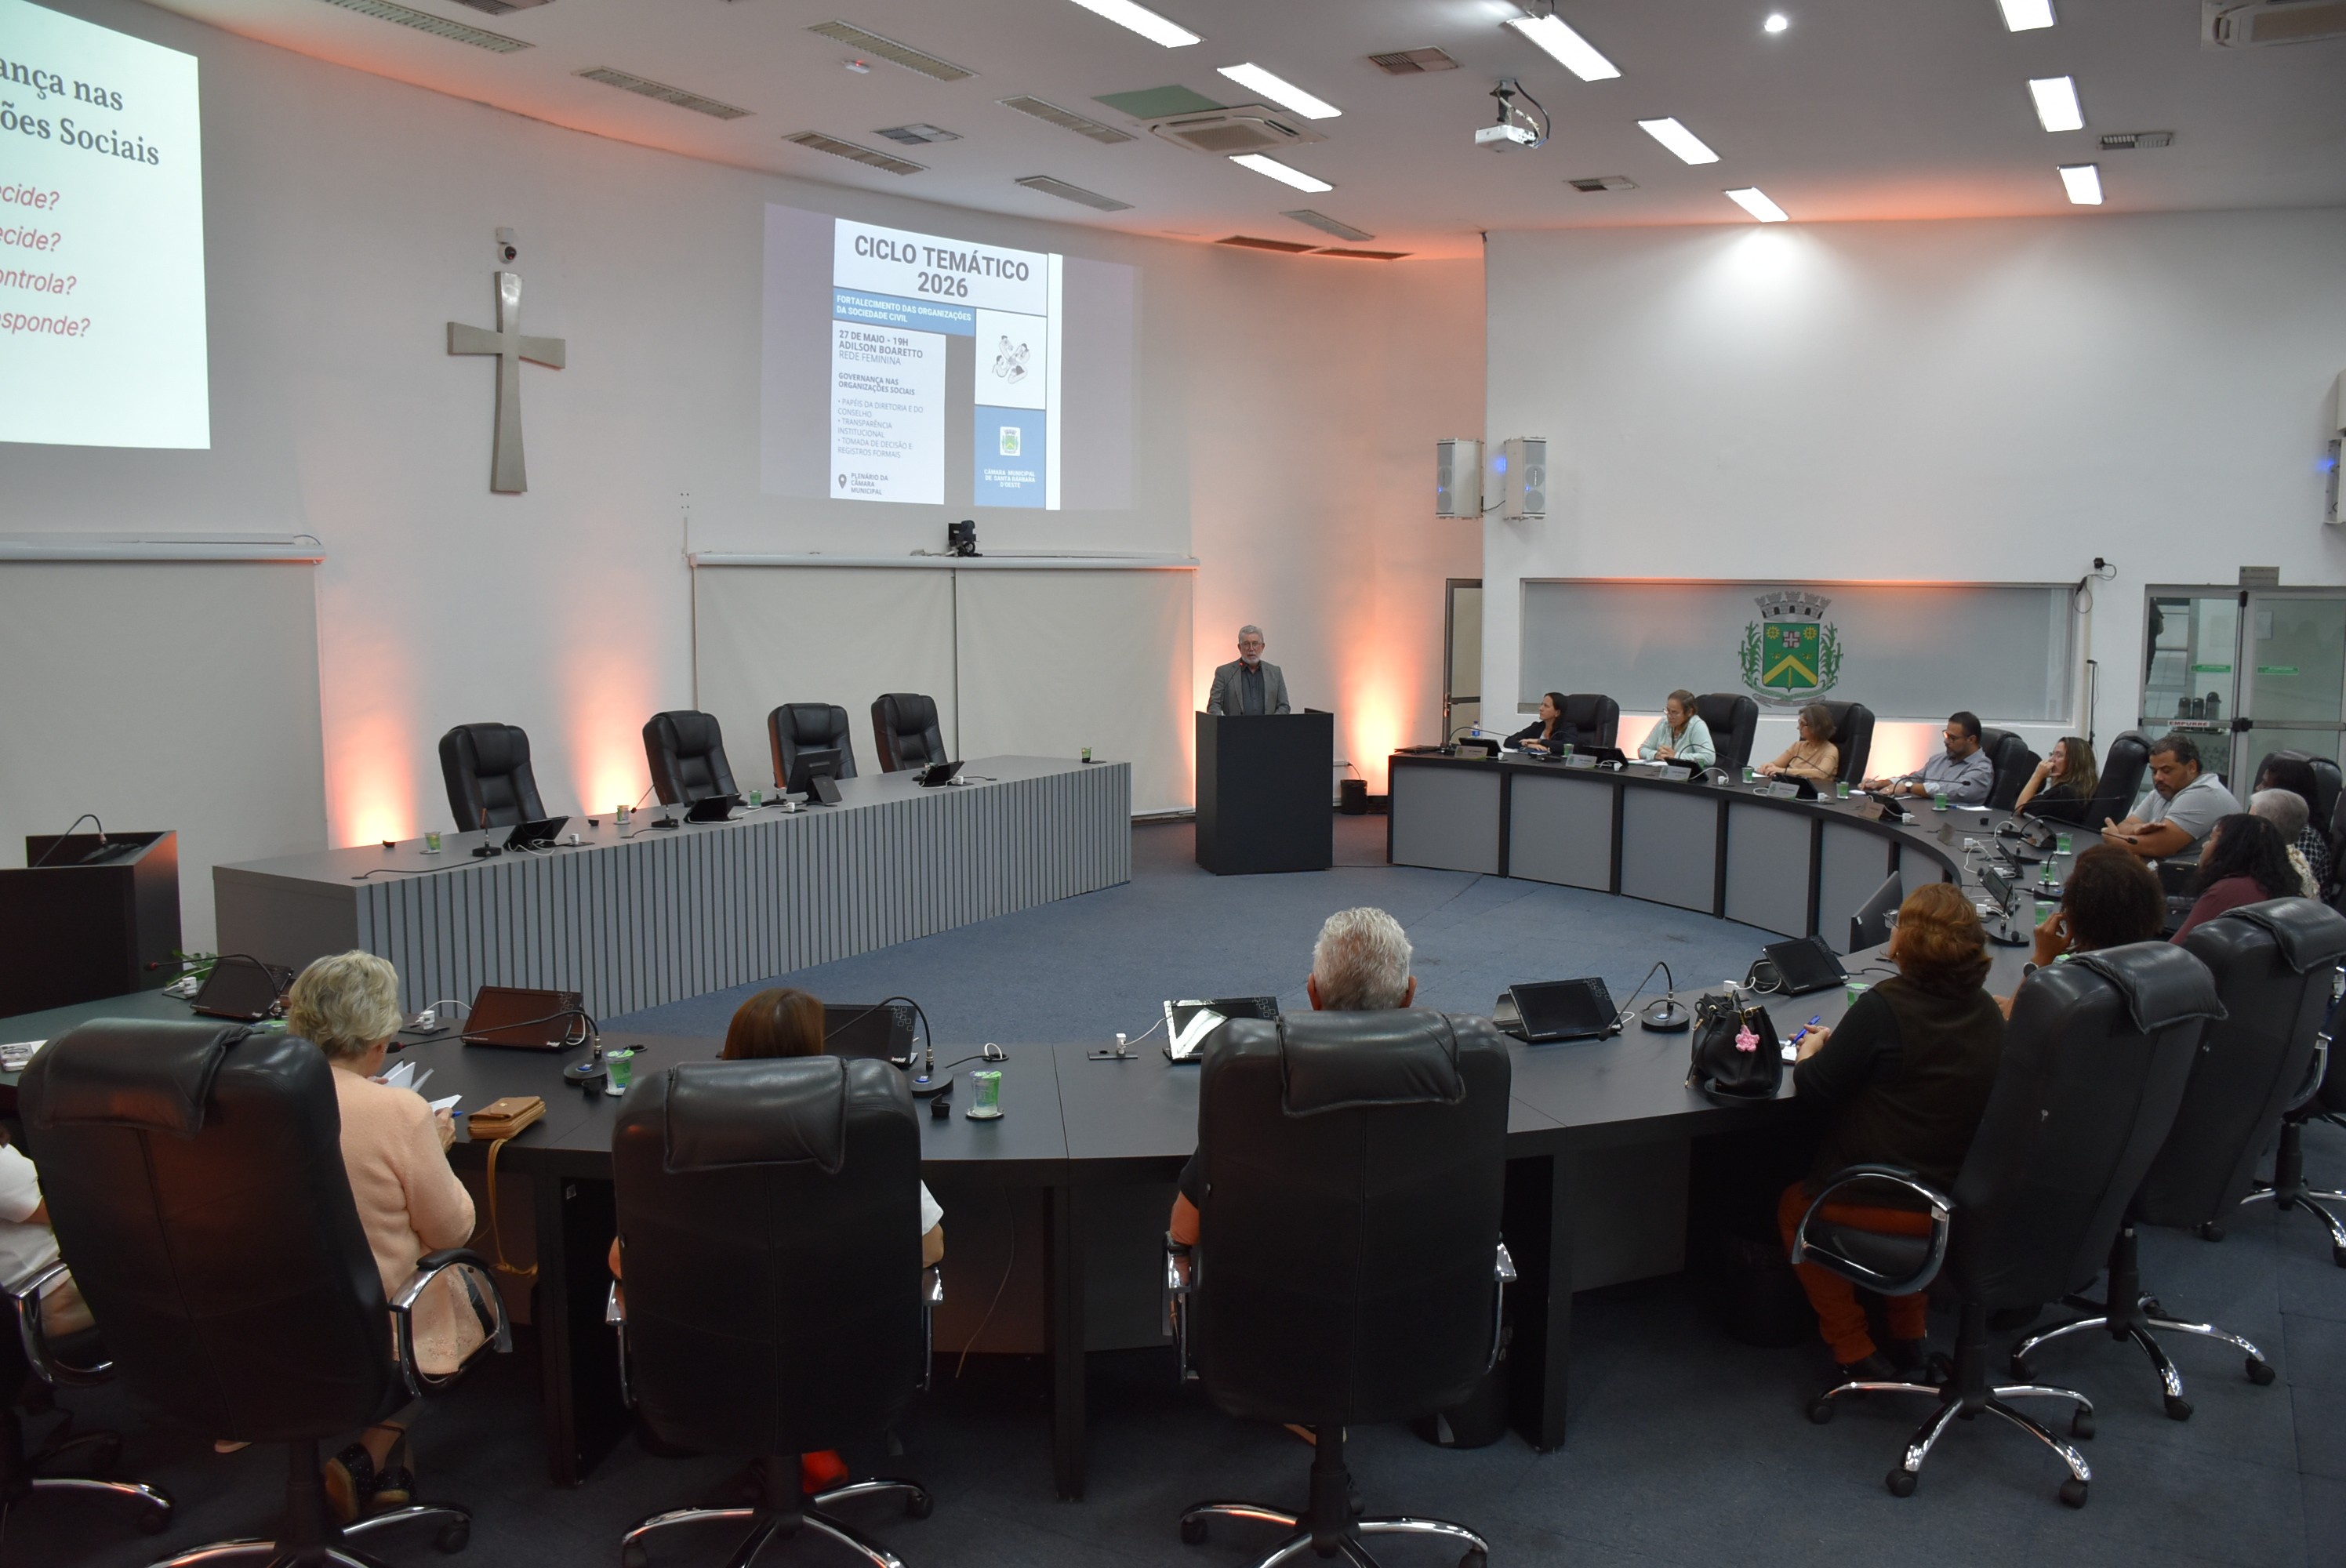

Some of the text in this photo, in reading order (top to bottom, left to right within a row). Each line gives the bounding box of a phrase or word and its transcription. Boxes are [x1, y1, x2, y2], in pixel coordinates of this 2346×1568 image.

[74, 80, 123, 111] nas
[60, 118, 159, 165] Sociais
[0, 183, 60, 210] cide?
[0, 226, 61, 252] cide?
[855, 234, 1030, 281] CICLO TEMÁTICO
[917, 271, 968, 298] 2026
[837, 295, 971, 321] FORTALECIMENTO DAS ORGANIZAÇÕES
[848, 307, 888, 320] SOCIEDADE
[889, 314, 908, 322] CIVIL
[0, 312, 91, 337] sponde?
[839, 330, 849, 339] 27
[851, 332, 861, 340] DE
[863, 333, 885, 343] MAIO
[893, 337, 909, 346] 19H
[839, 340, 923, 358] ADILSON BOARETTO
[839, 350, 901, 365] REDE FEMININA
[838, 372, 884, 384] GOVERNANÇA
[838, 381, 915, 395] ORGANIZAÇÕES SOCIAIS
[842, 398, 862, 407] PAPÉIS
[874, 401, 907, 412] DIRETORIA
[837, 408, 872, 418] CONSELHO
[841, 418, 892, 429] TRANSPARÊNCIA
[837, 427, 884, 437] INSTITUCIONAL
[841, 437, 869, 446] TOMADA
[881, 441, 907, 449] DECISÃO
[837, 447, 871, 456] REGISTROS
